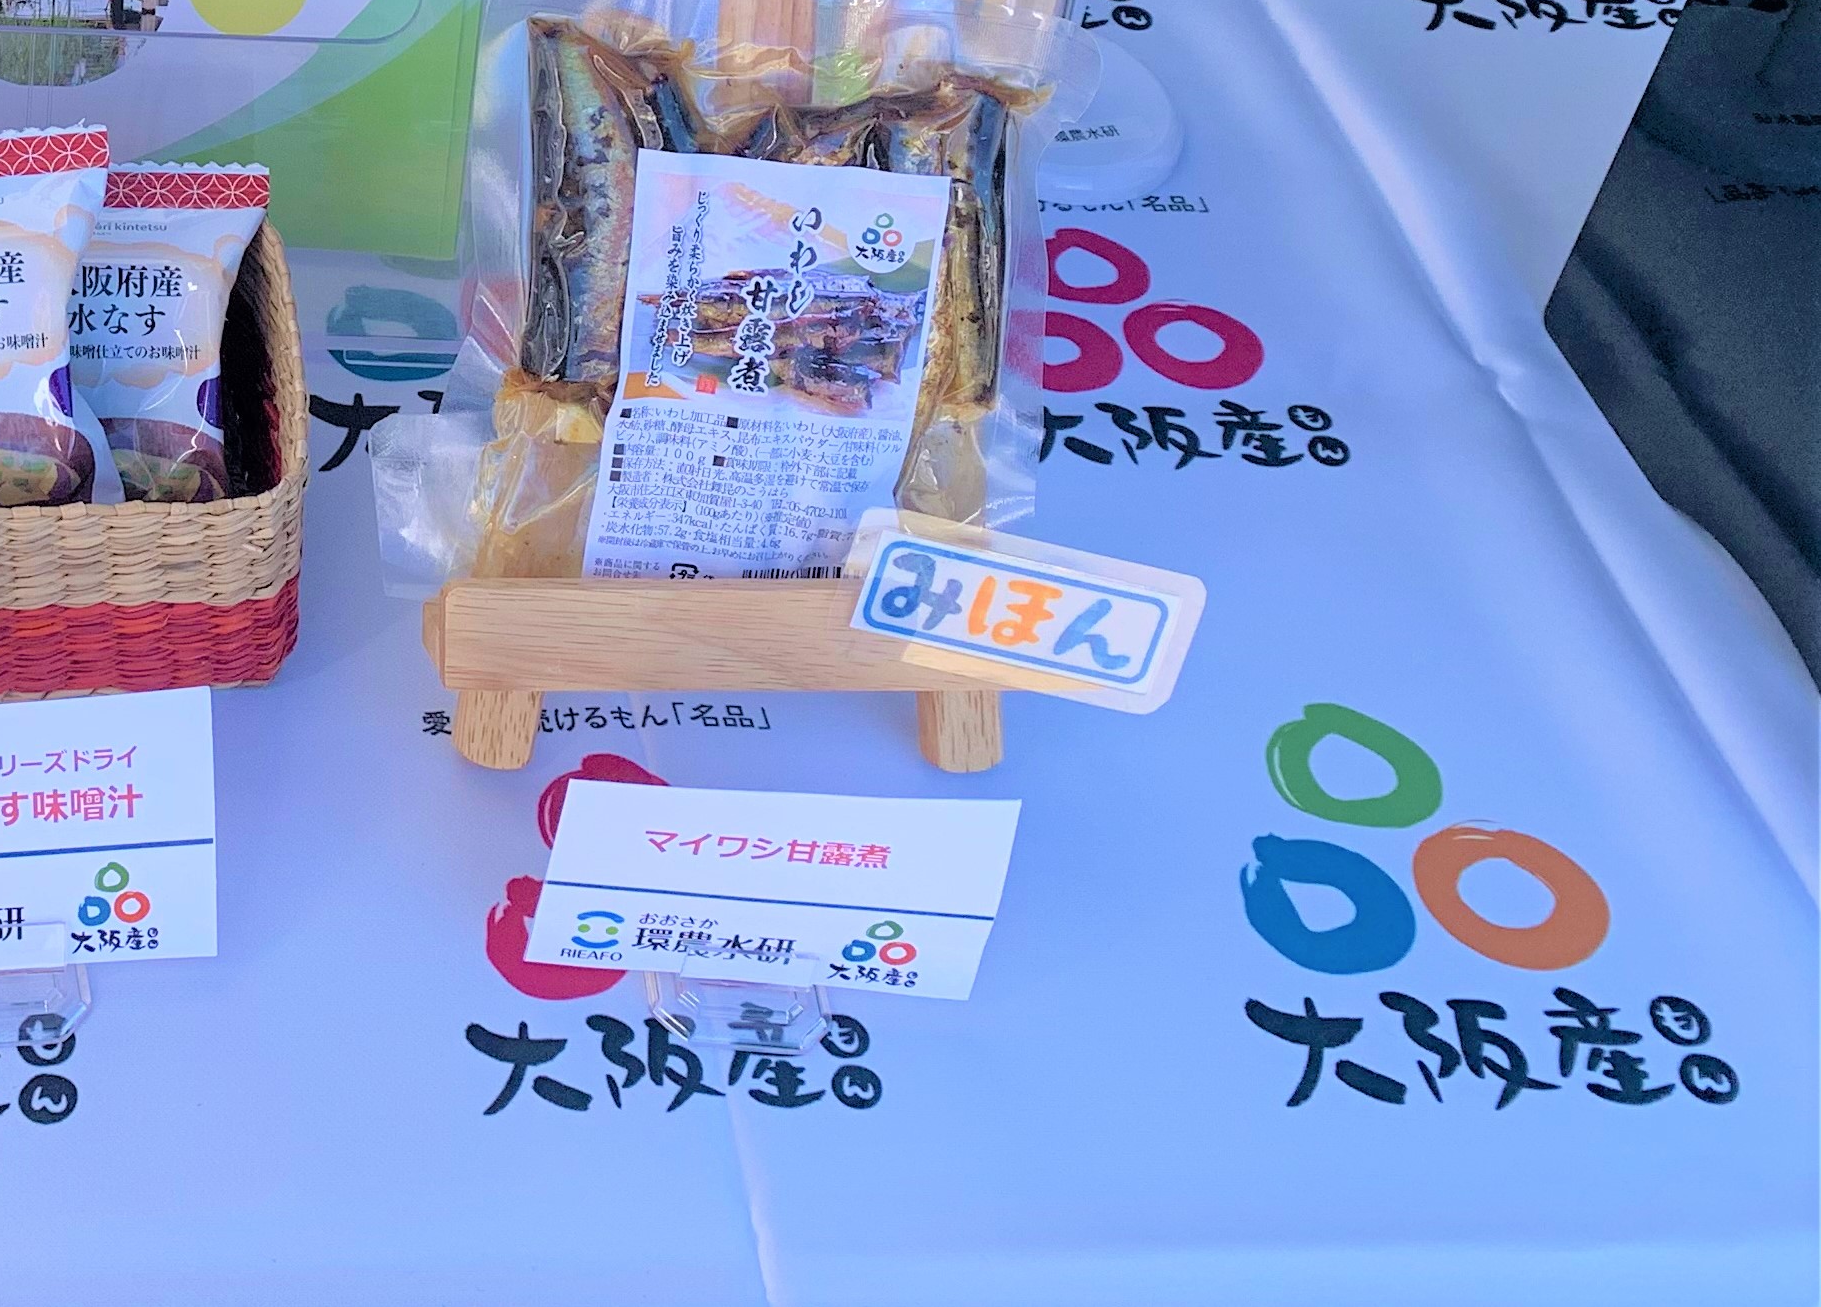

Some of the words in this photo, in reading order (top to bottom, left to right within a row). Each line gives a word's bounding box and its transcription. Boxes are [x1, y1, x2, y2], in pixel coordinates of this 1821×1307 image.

[71, 264, 183, 298] 阪府産
[790, 206, 823, 316] いわし
[67, 303, 167, 337] 水なす
[731, 279, 778, 394] 甘露煮
[880, 551, 1132, 672] みほん
[643, 828, 893, 871] マイワシ甘露煮
[637, 912, 720, 930] おおさか
[558, 944, 624, 964] RIEAFO
[631, 925, 798, 968] 環農水研
